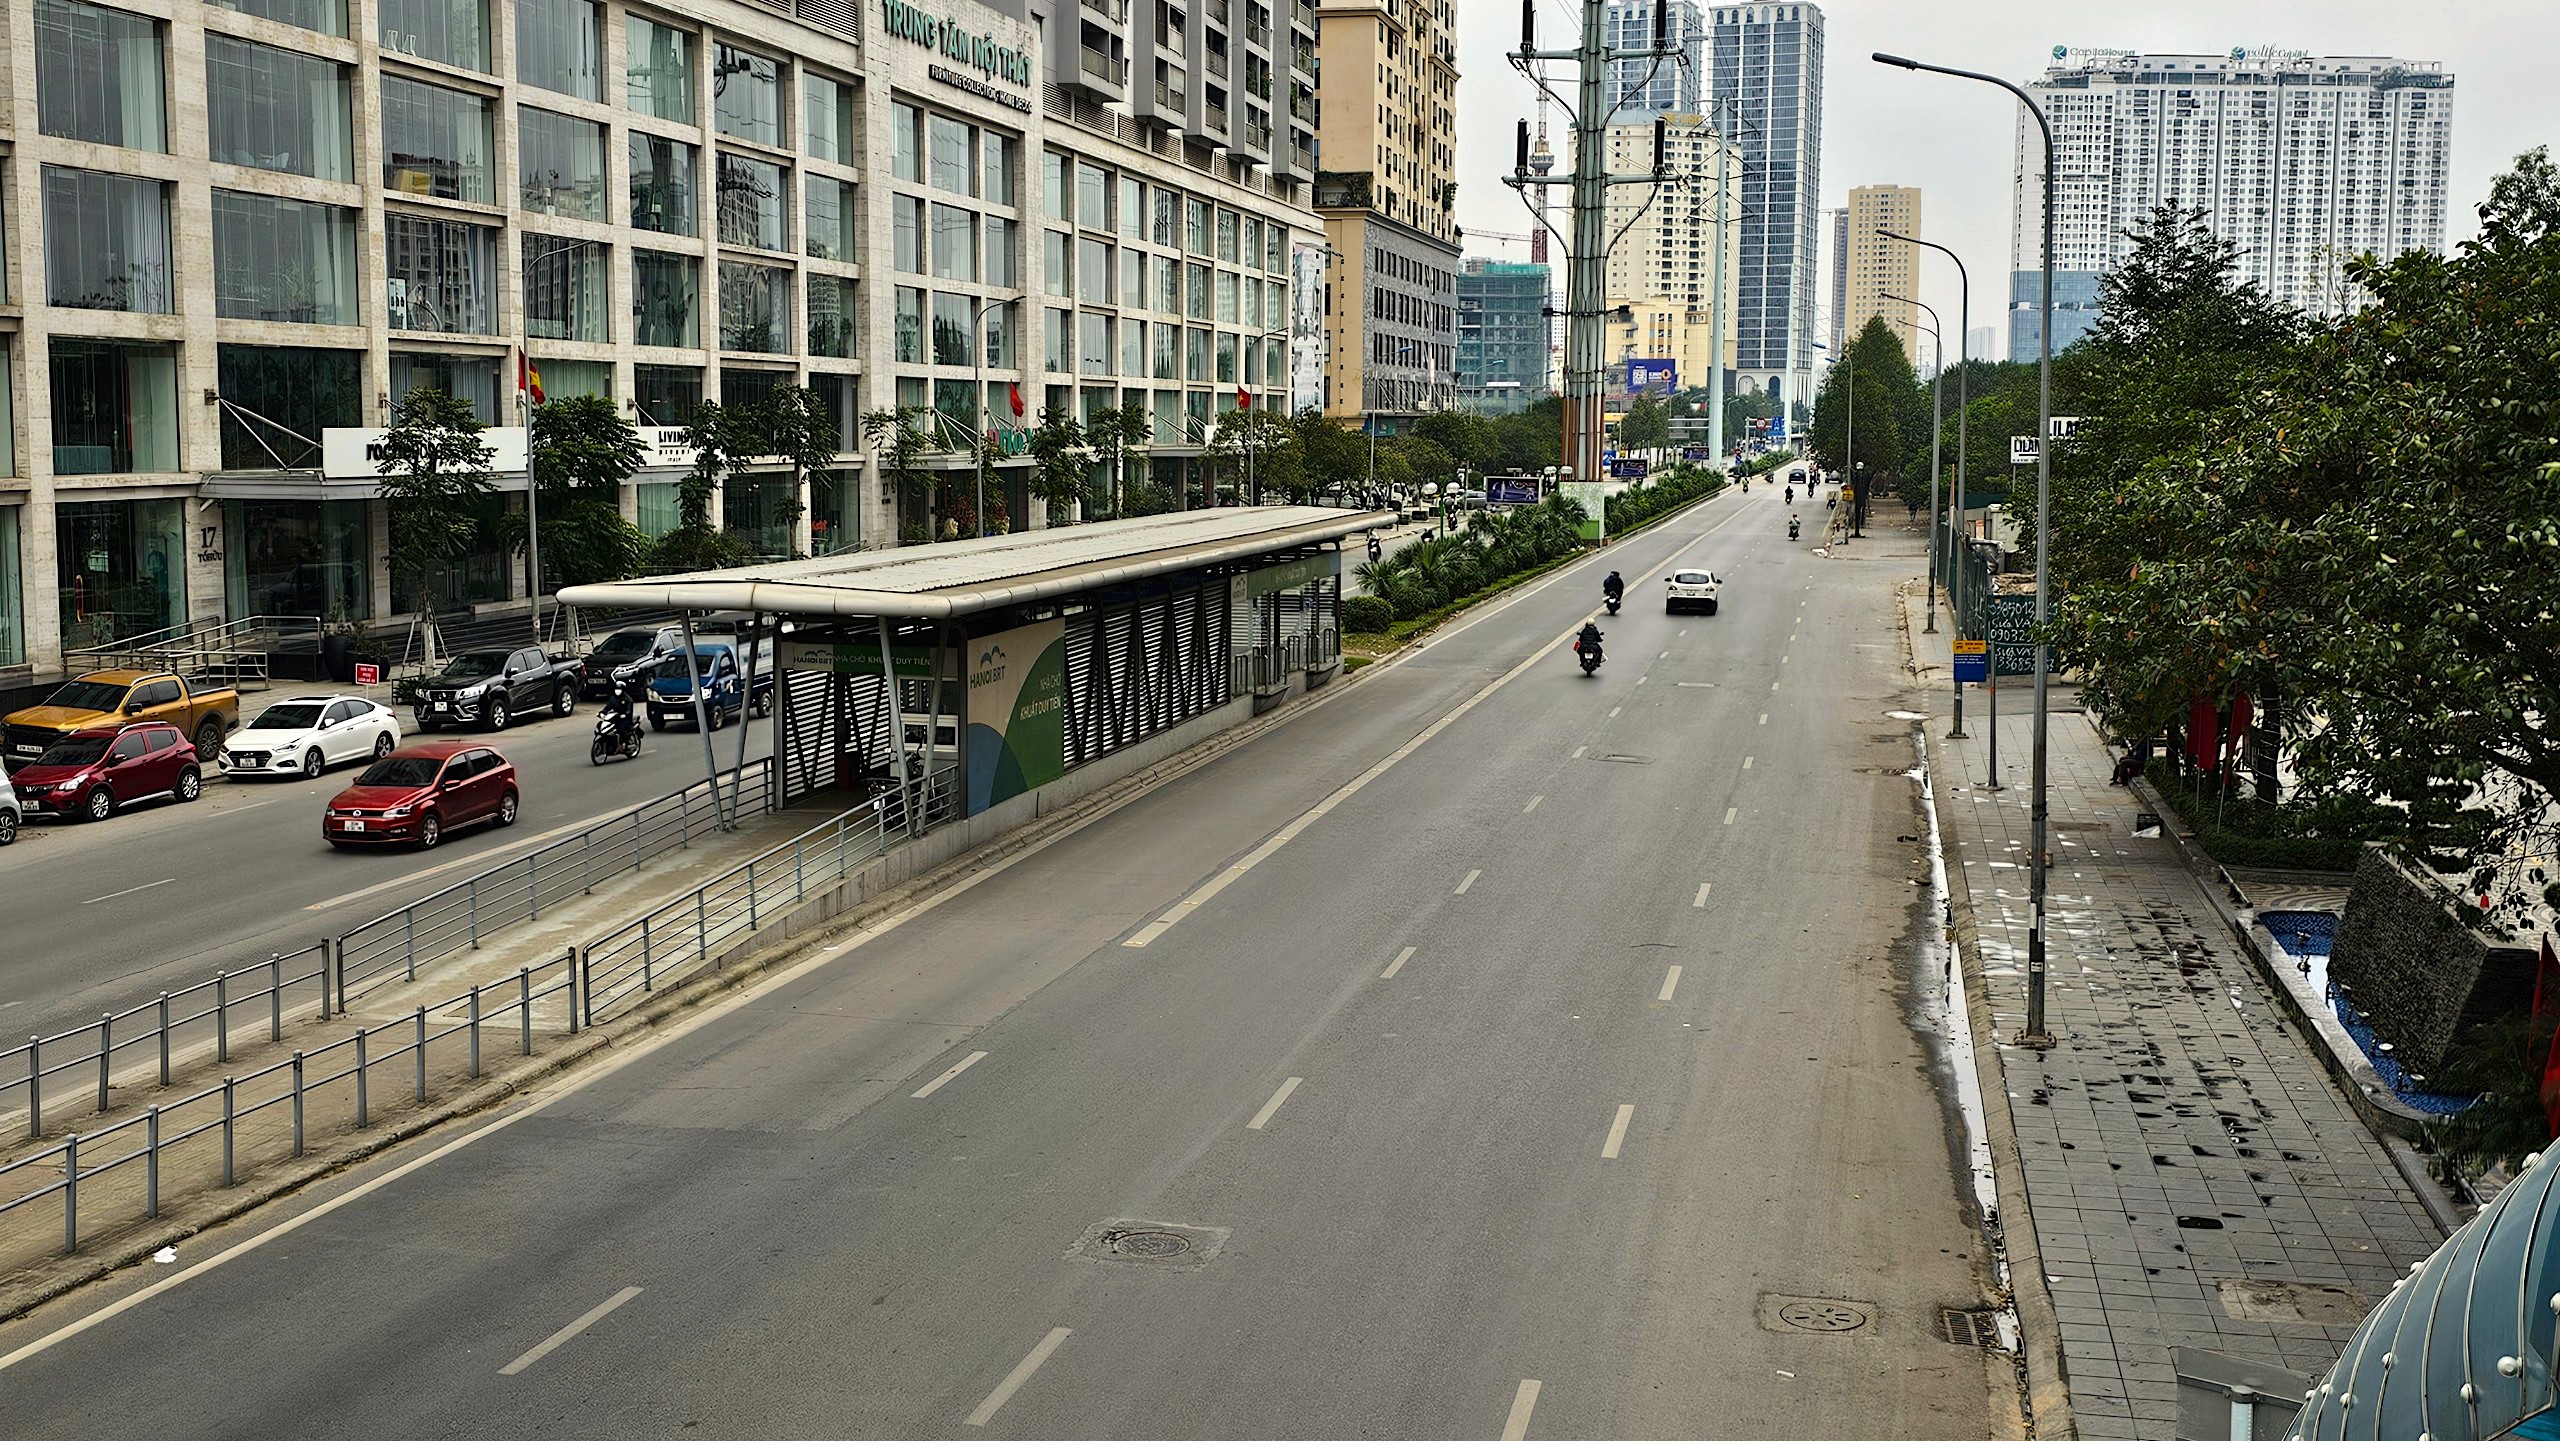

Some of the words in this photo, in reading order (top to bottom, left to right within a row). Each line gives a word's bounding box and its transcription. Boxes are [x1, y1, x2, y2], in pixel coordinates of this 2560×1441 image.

[883, 0, 937, 49] TRUNG
[939, 16, 970, 64] TÂM
[972, 32, 998, 81] NỘI
[999, 43, 1033, 88] THẤT
[200, 526, 217, 549] 17
[896, 657, 911, 666] DUY
[969, 669, 993, 690] HANOI
[992, 664, 1006, 682] BRT
